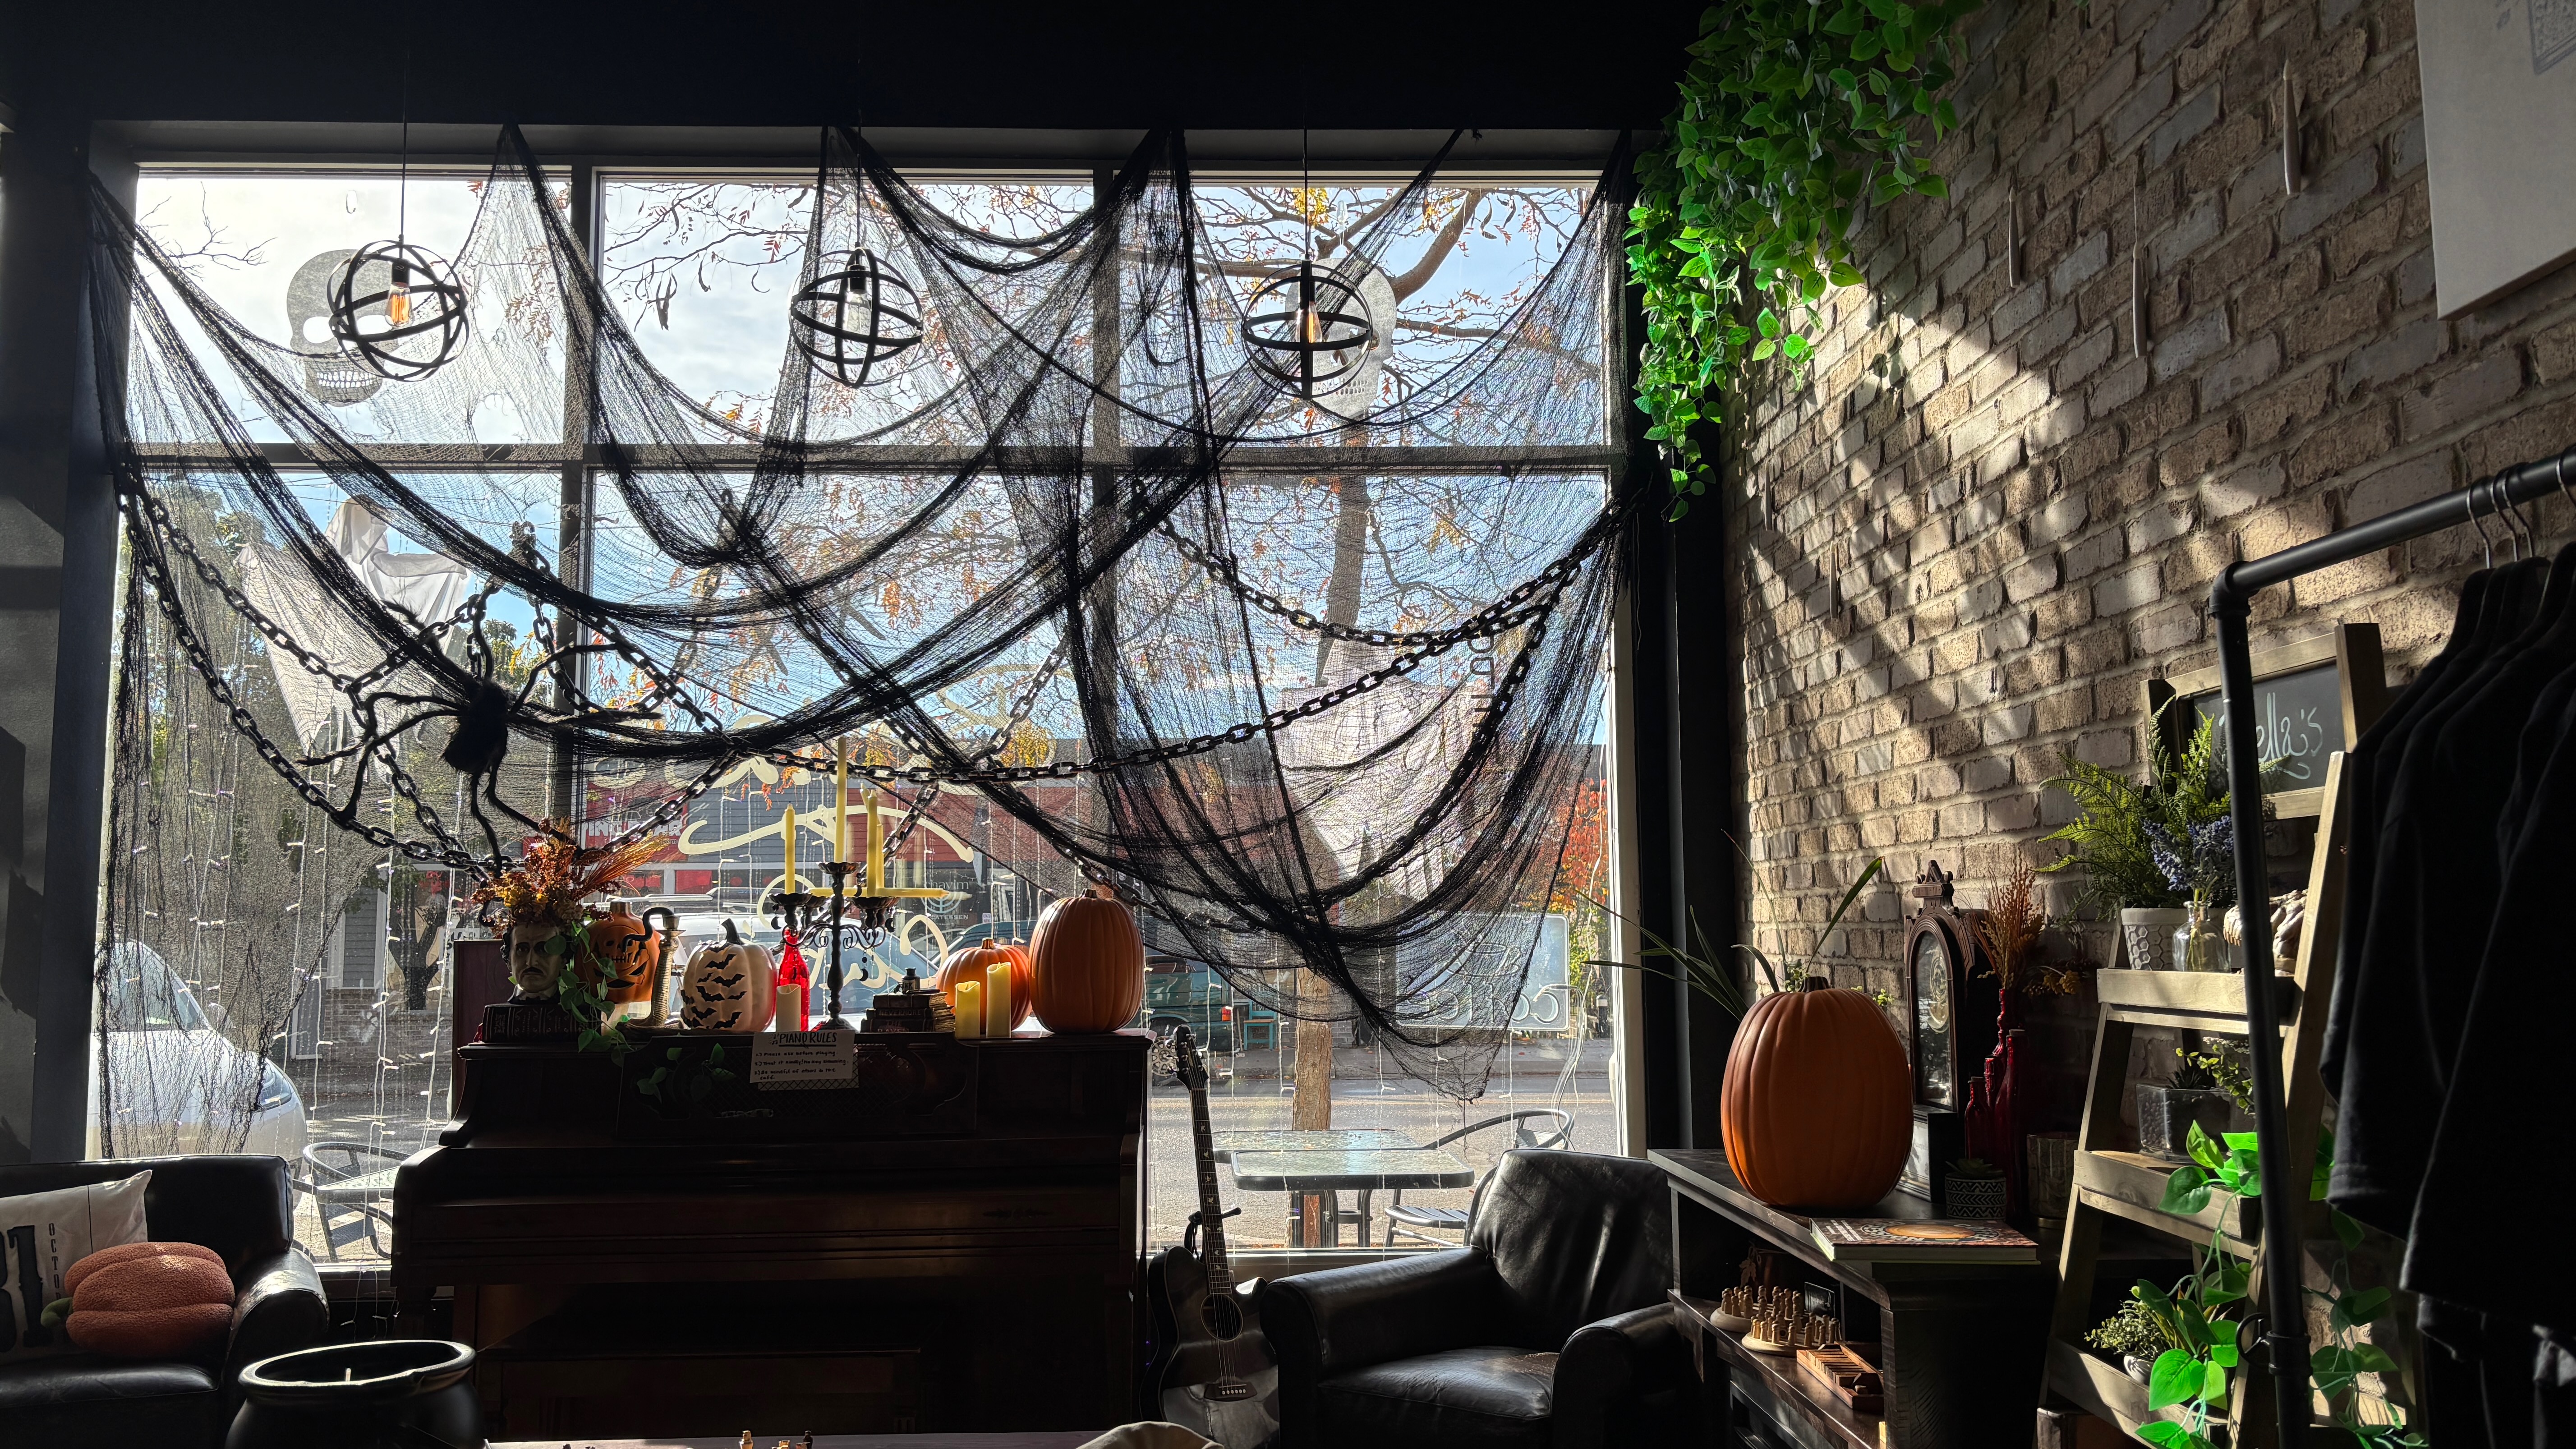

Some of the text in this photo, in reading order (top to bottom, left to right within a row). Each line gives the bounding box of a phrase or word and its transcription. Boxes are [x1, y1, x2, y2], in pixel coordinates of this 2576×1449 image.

[2219, 692, 2323, 762] ella's
[779, 1032, 837, 1044] PIANO RULES
